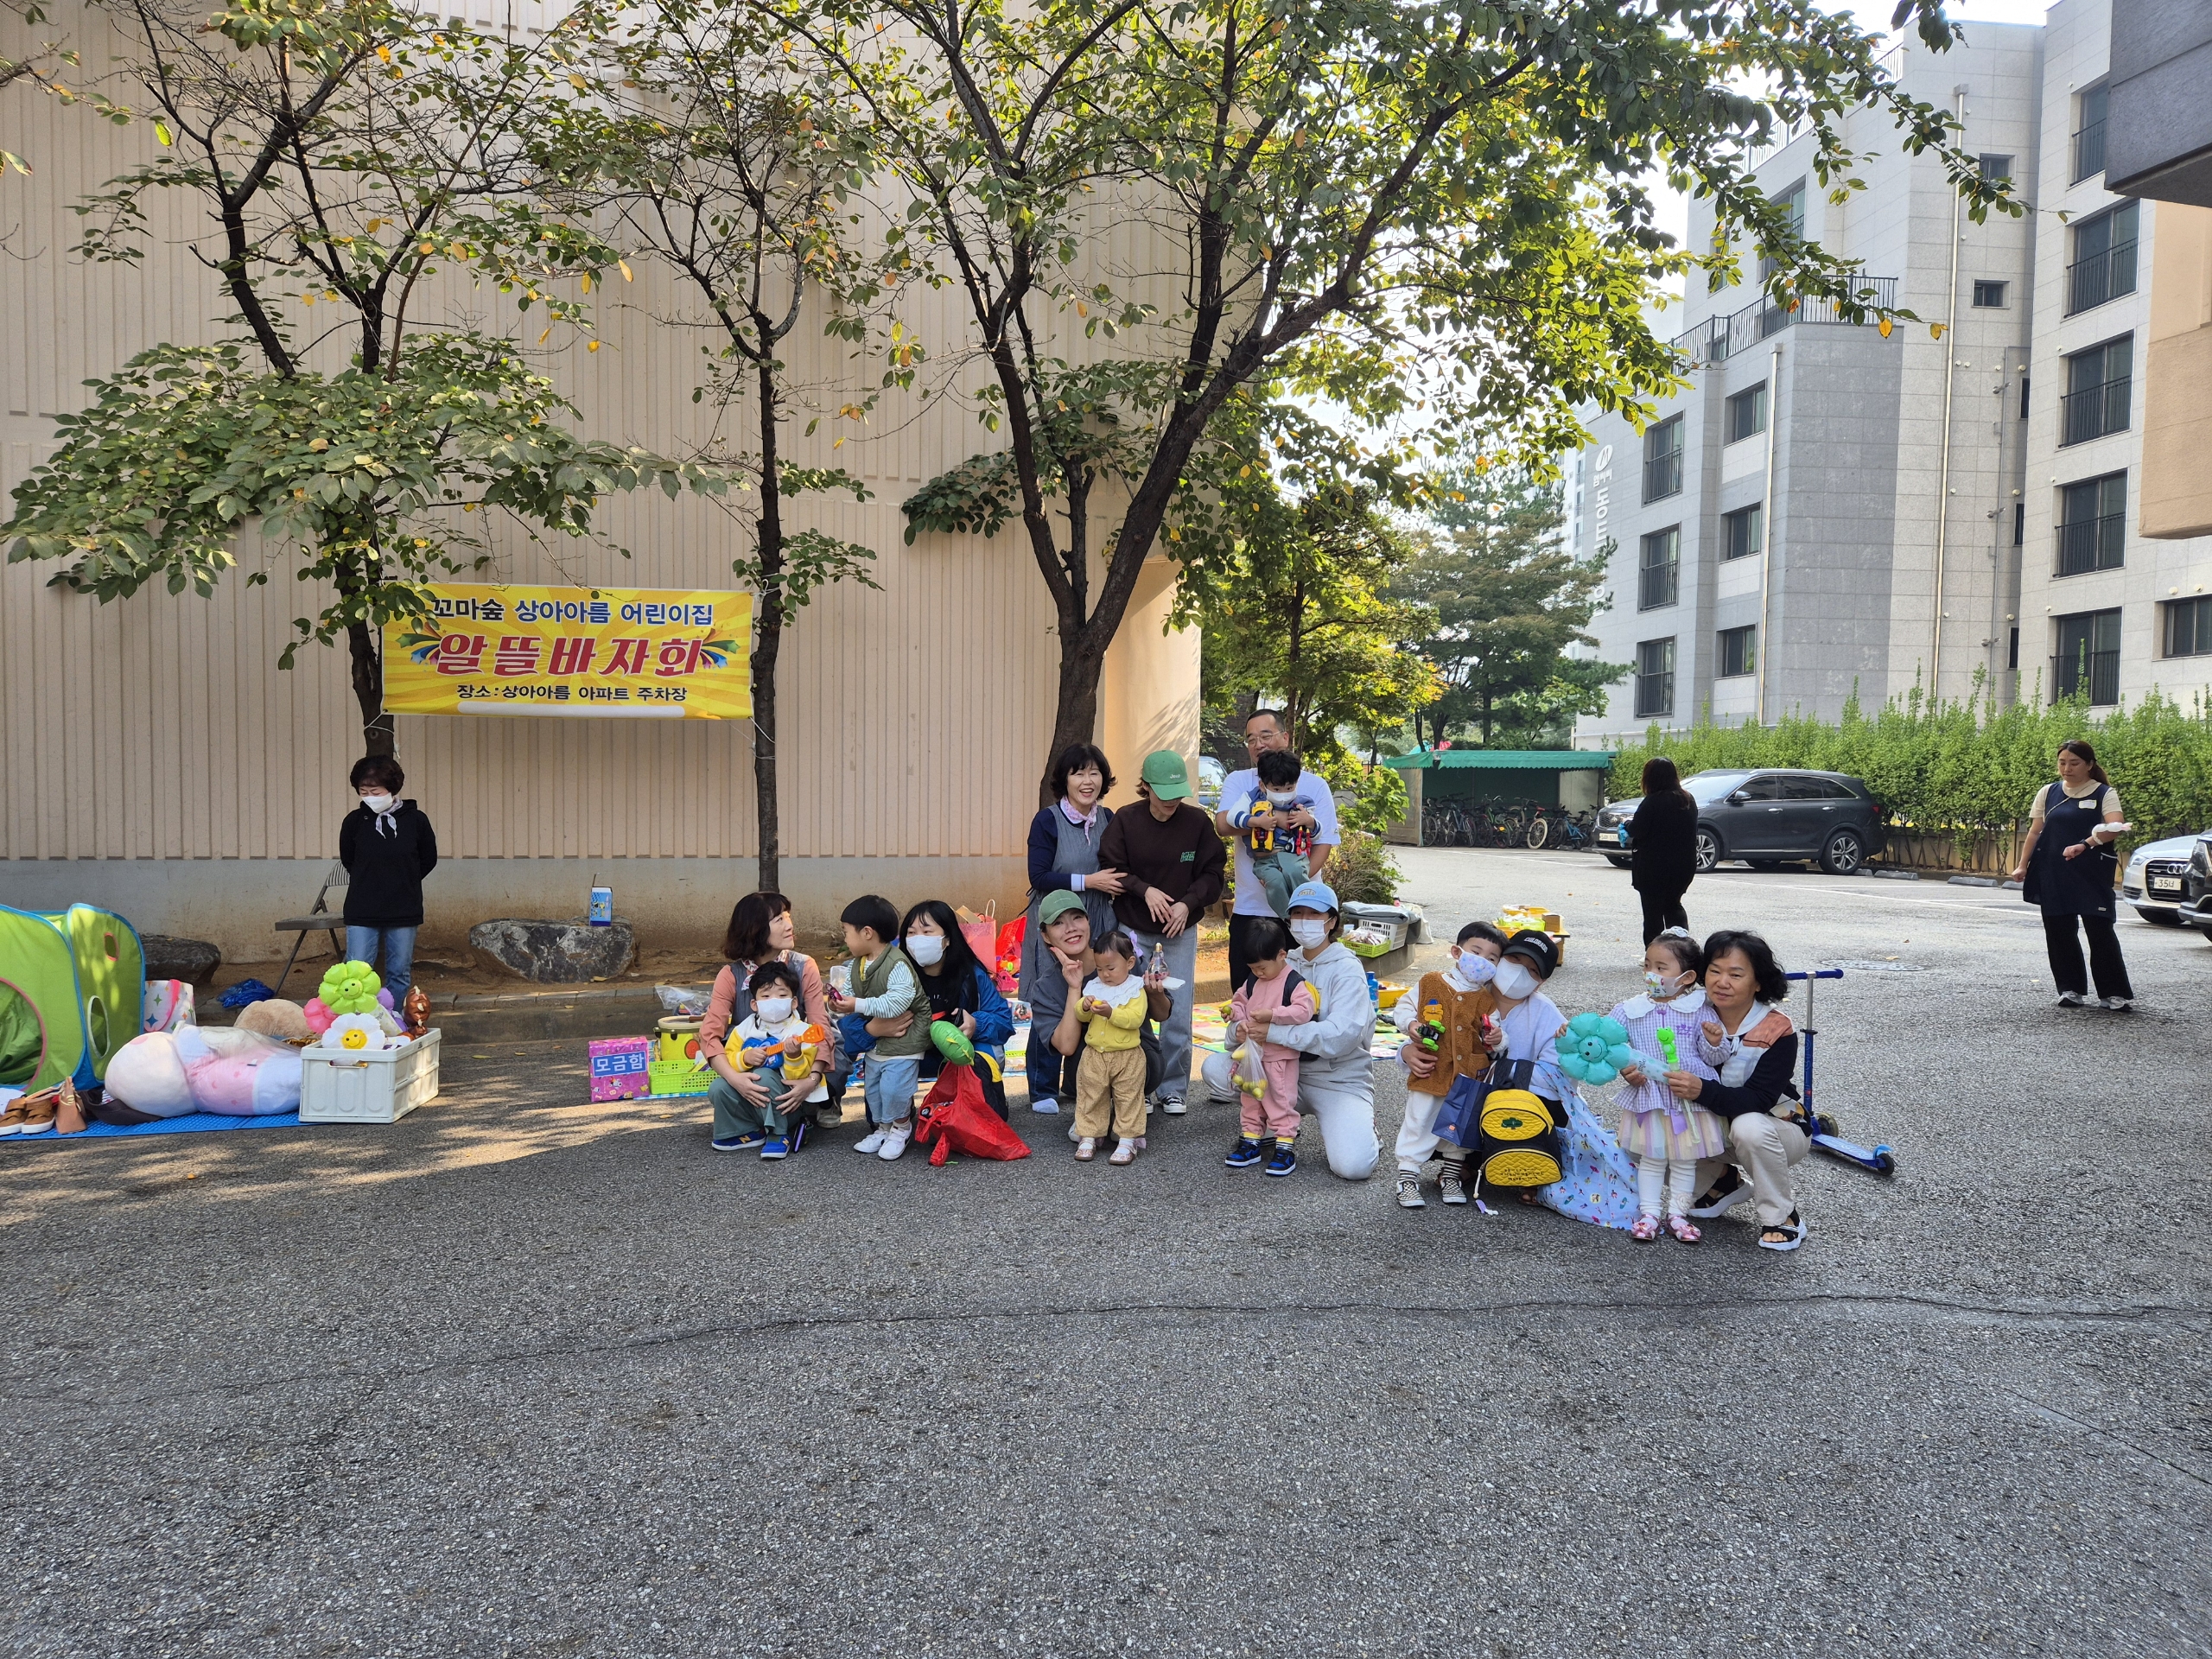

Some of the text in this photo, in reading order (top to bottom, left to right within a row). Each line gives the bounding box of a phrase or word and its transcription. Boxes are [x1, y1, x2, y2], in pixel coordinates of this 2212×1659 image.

[432, 598, 713, 626] 꼬마숲 상아아름 어린이집
[435, 633, 703, 677] 알뜰바자회
[578, 686, 630, 701] 아파트
[636, 687, 688, 702] 주차장
[594, 1053, 645, 1072] 모금함
